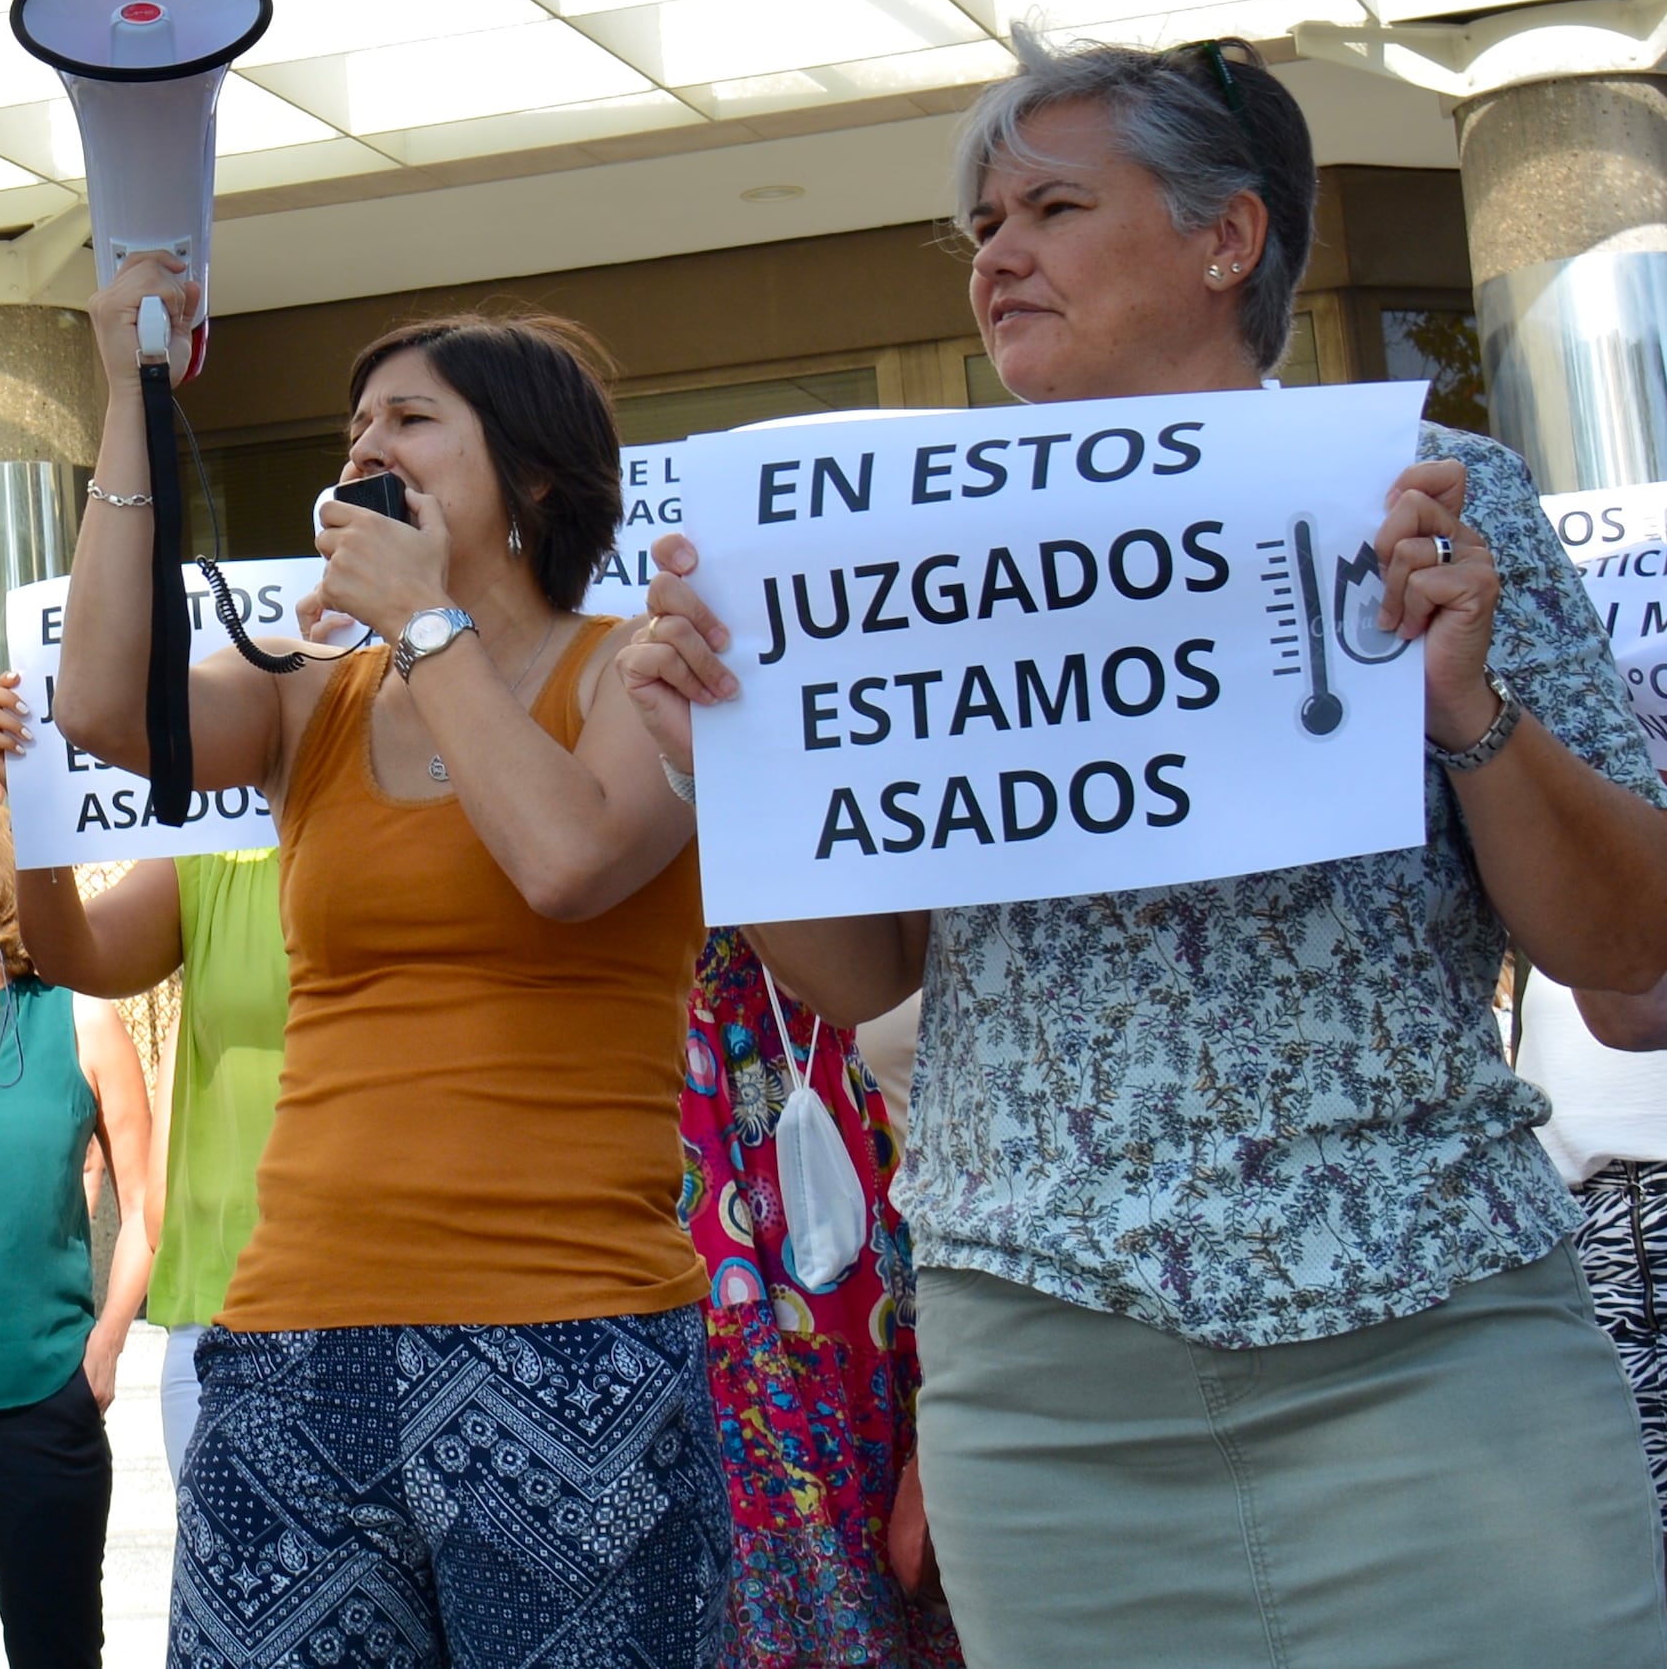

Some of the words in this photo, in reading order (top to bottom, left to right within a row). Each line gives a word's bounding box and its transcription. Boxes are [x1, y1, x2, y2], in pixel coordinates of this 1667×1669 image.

[758, 452, 875, 525] EN
[911, 422, 1205, 505] ESTOS
[758, 520, 1230, 665] JUZGADOS
[801, 638, 1221, 751] ESTAMOS
[815, 753, 1190, 860] ASADOS
